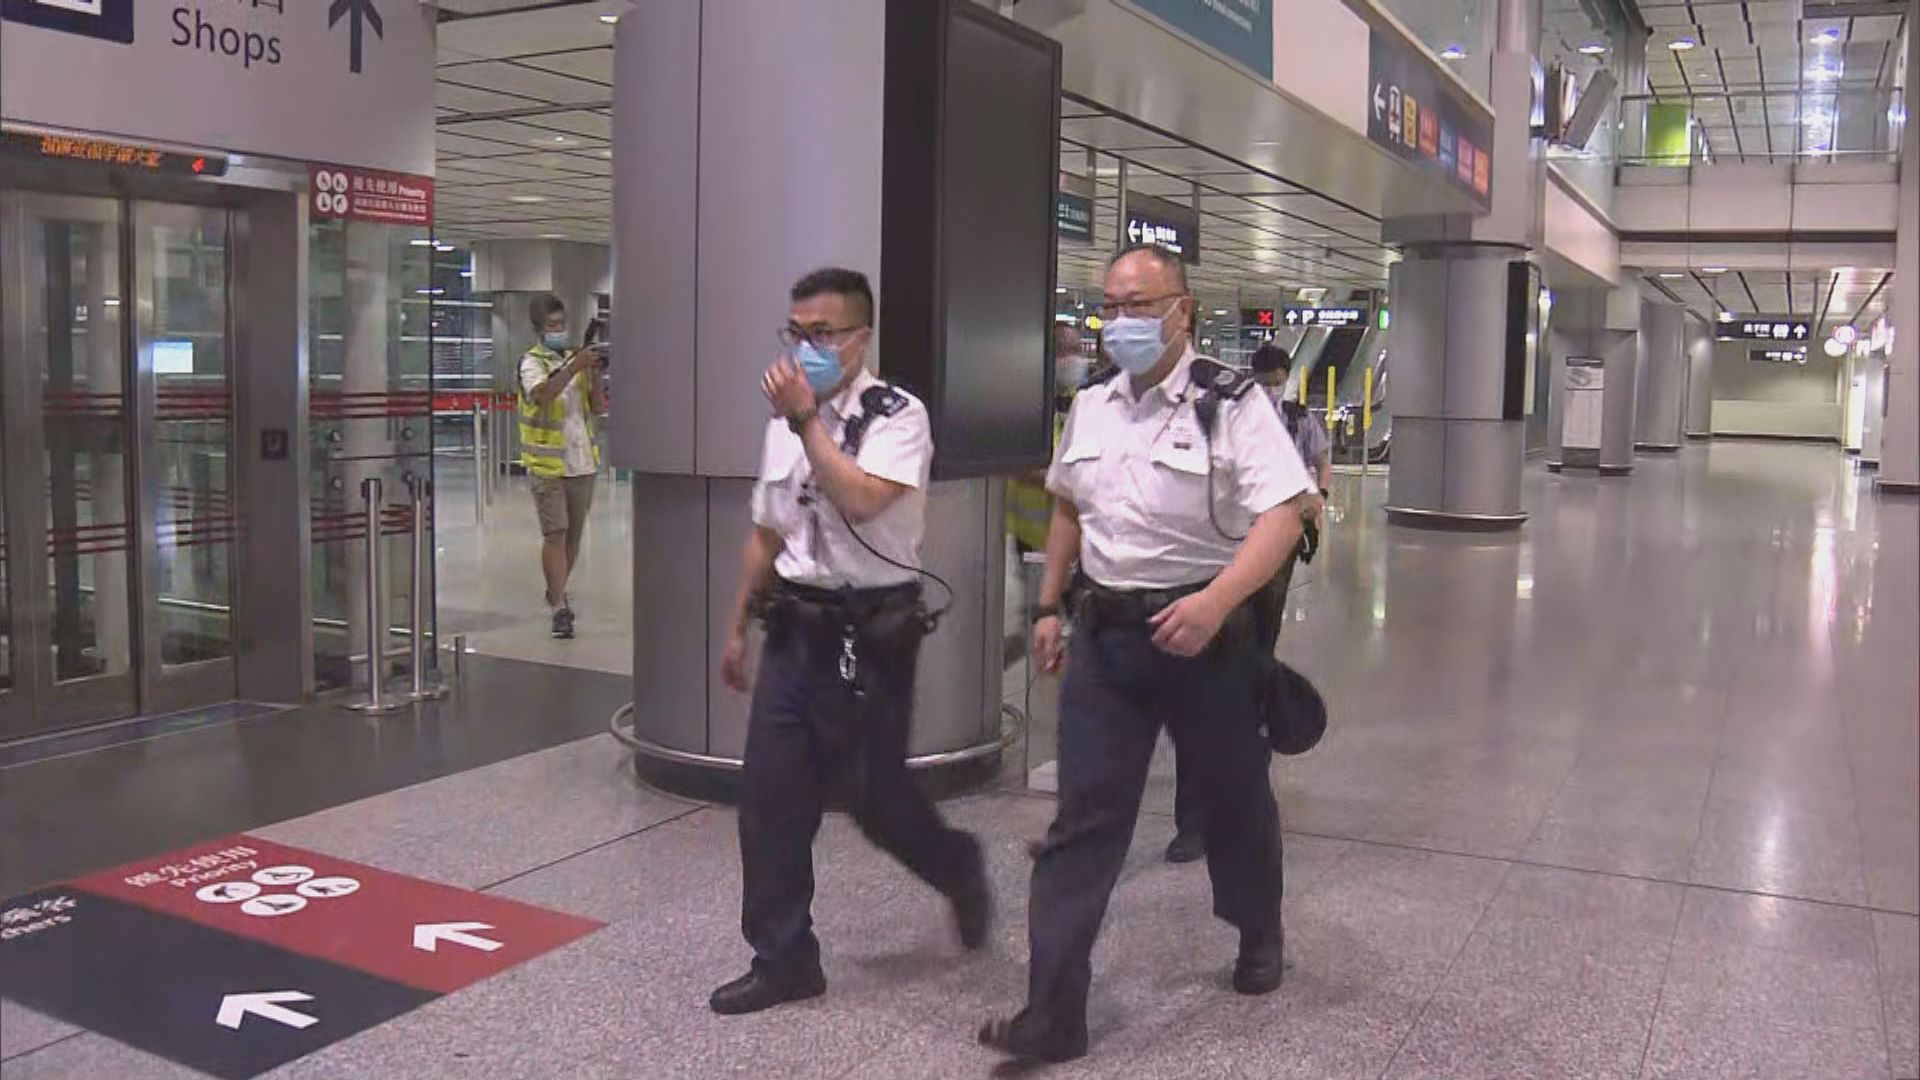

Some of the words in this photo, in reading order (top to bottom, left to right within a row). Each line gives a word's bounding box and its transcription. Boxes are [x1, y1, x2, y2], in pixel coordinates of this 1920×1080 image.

[171, 7, 281, 68] Shops
[398, 185, 426, 199] Priority
[168, 859, 258, 888] Priority
